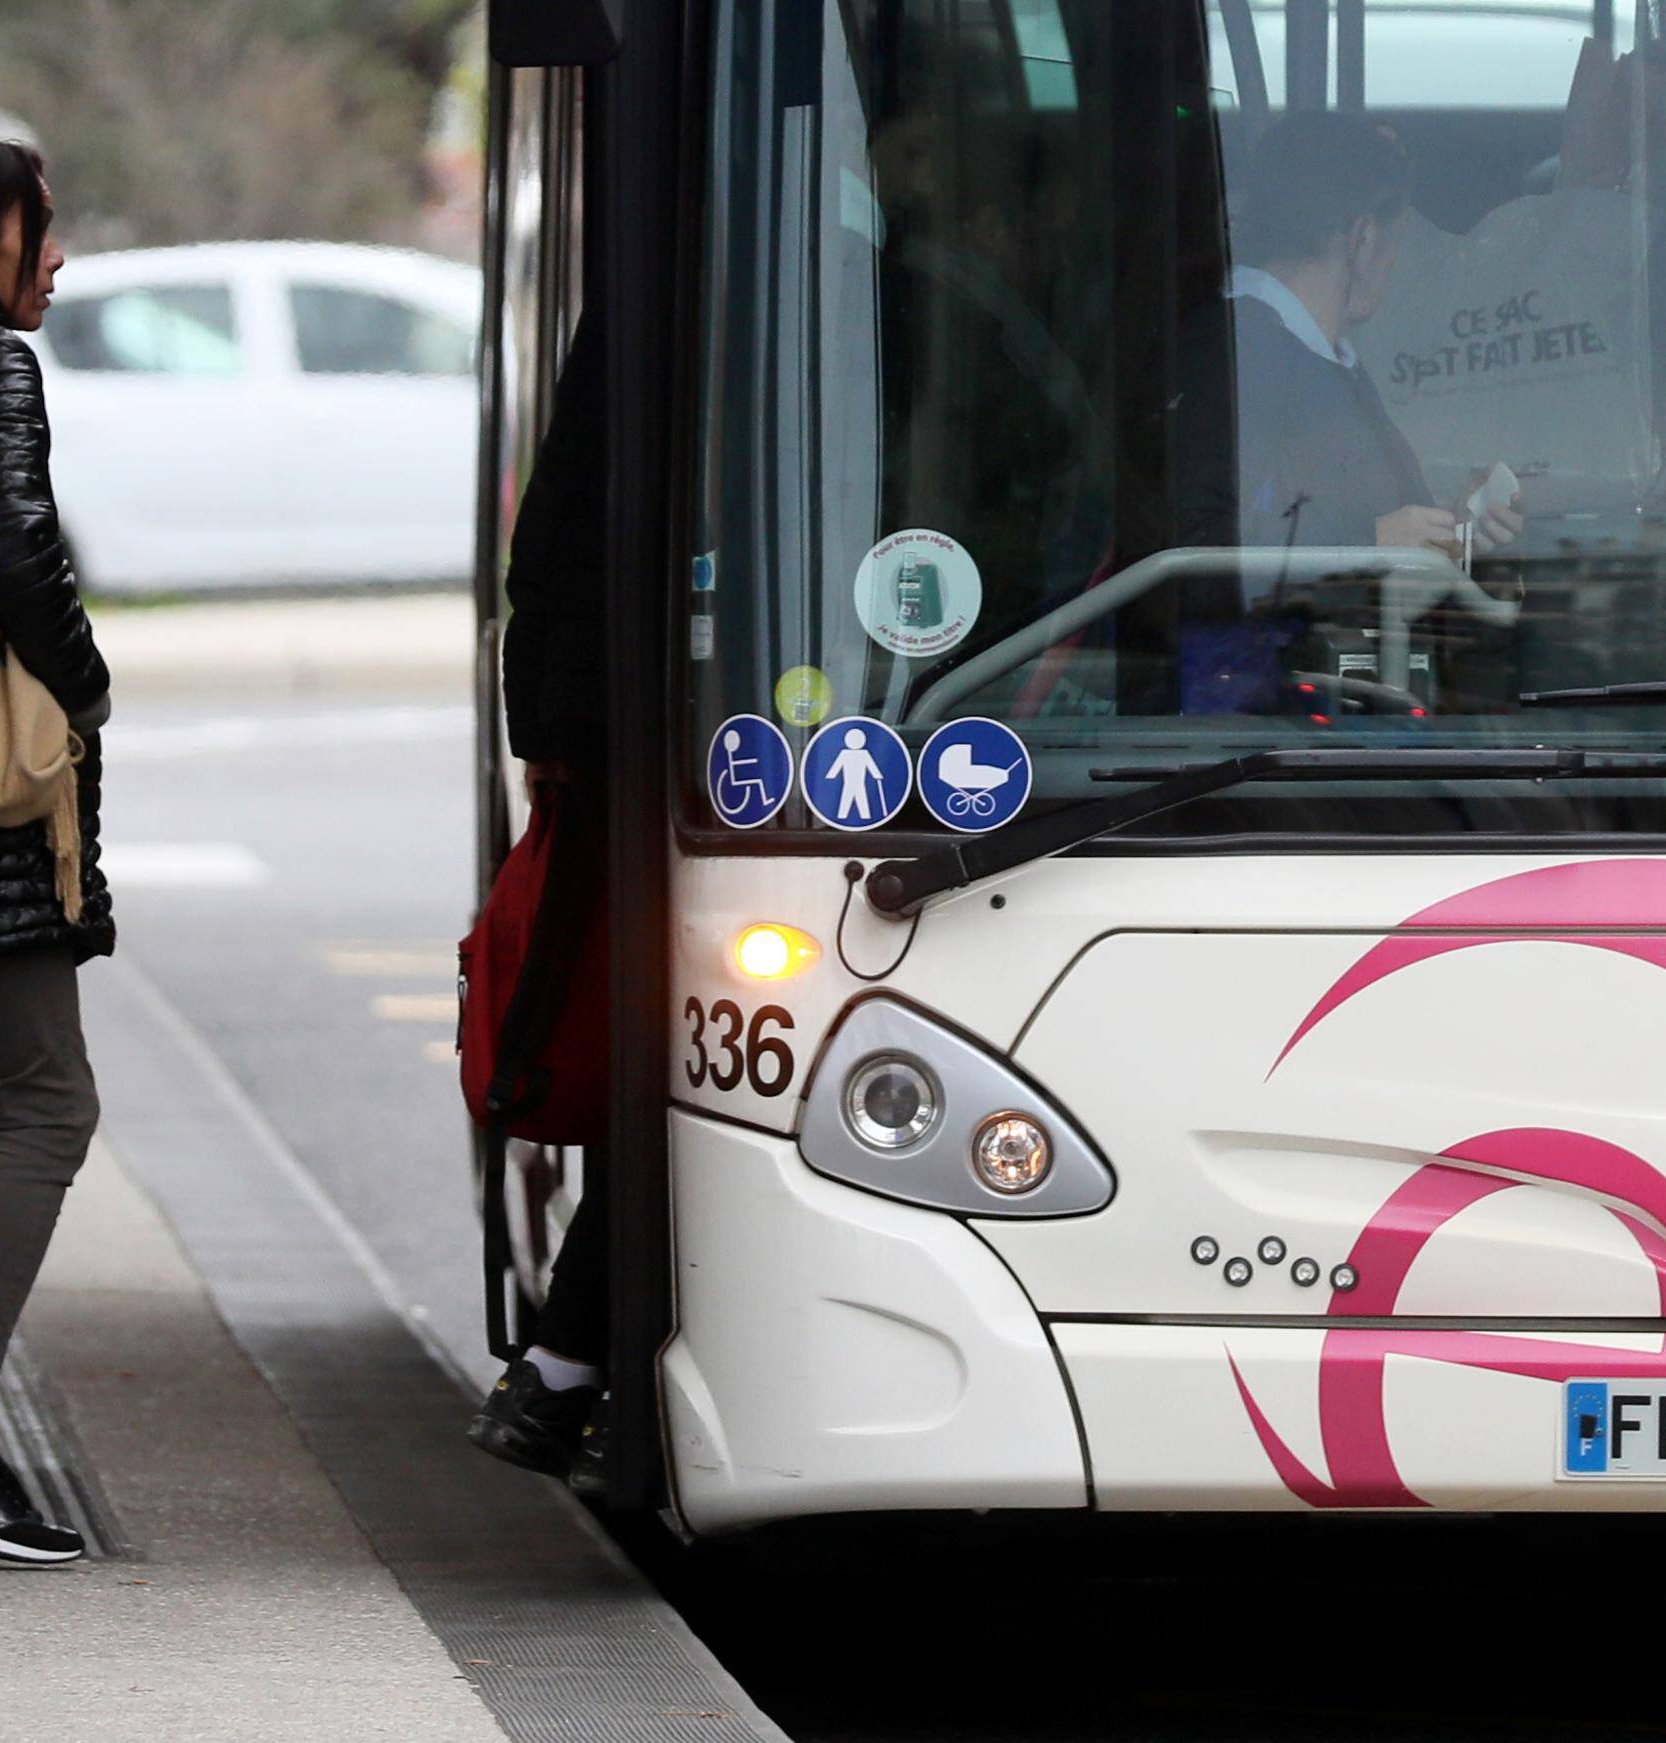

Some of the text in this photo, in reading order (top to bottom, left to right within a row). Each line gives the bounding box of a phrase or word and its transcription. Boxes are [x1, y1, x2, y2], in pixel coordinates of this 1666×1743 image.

[1449, 306, 1487, 339] CE
[683, 996, 796, 1098] 336
[1580, 1438, 1593, 1456] F
